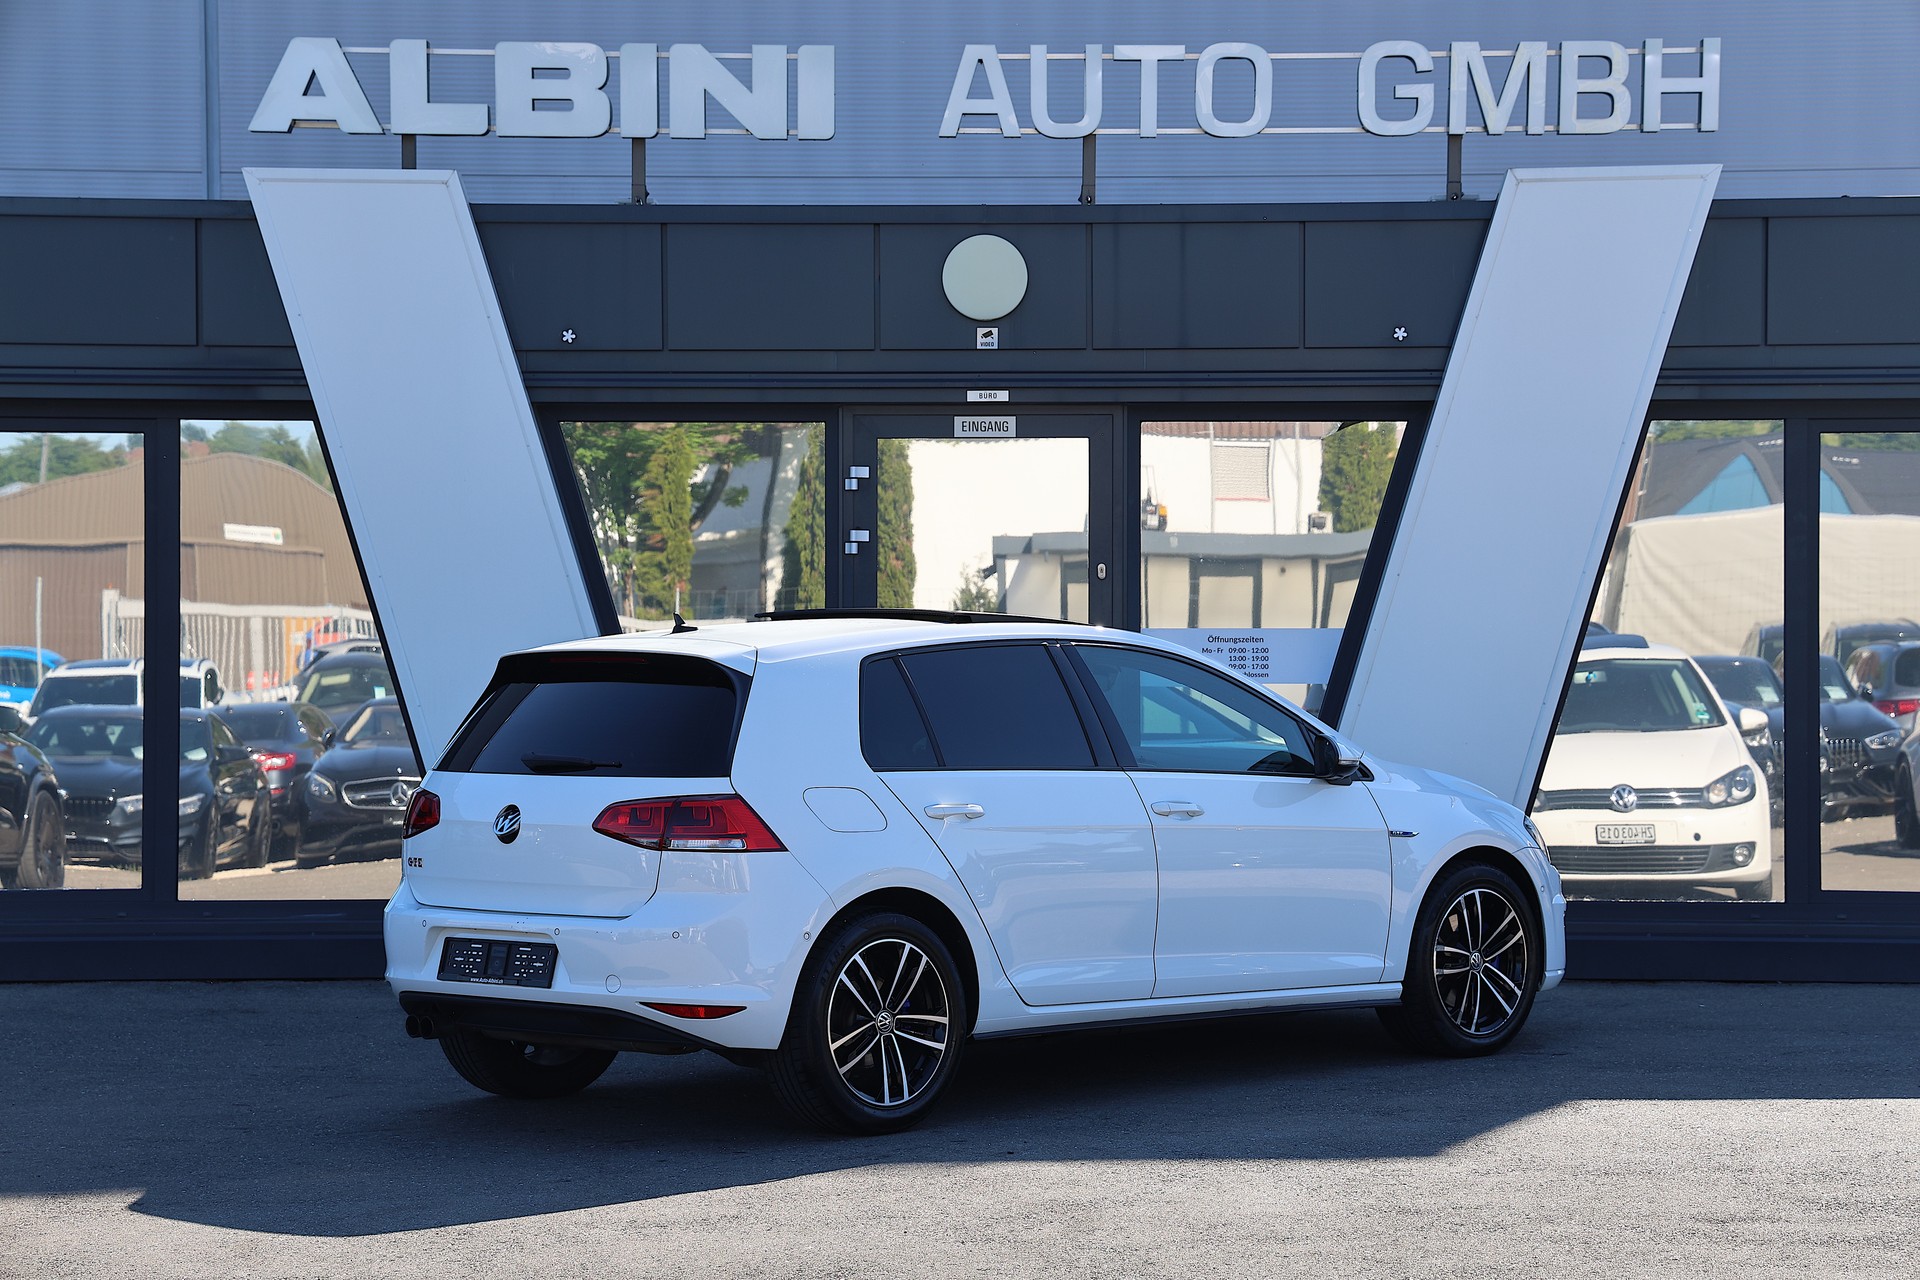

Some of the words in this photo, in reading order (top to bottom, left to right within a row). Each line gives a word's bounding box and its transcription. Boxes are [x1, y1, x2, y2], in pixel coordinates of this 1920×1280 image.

[248, 37, 835, 140] ALBINI
[938, 41, 1273, 139] AUTO
[1356, 37, 1722, 137] GMBH
[961, 420, 1009, 432] EINGANG
[1207, 634, 1264, 644] Öffnungszeiten
[407, 857, 423, 868] GTE
